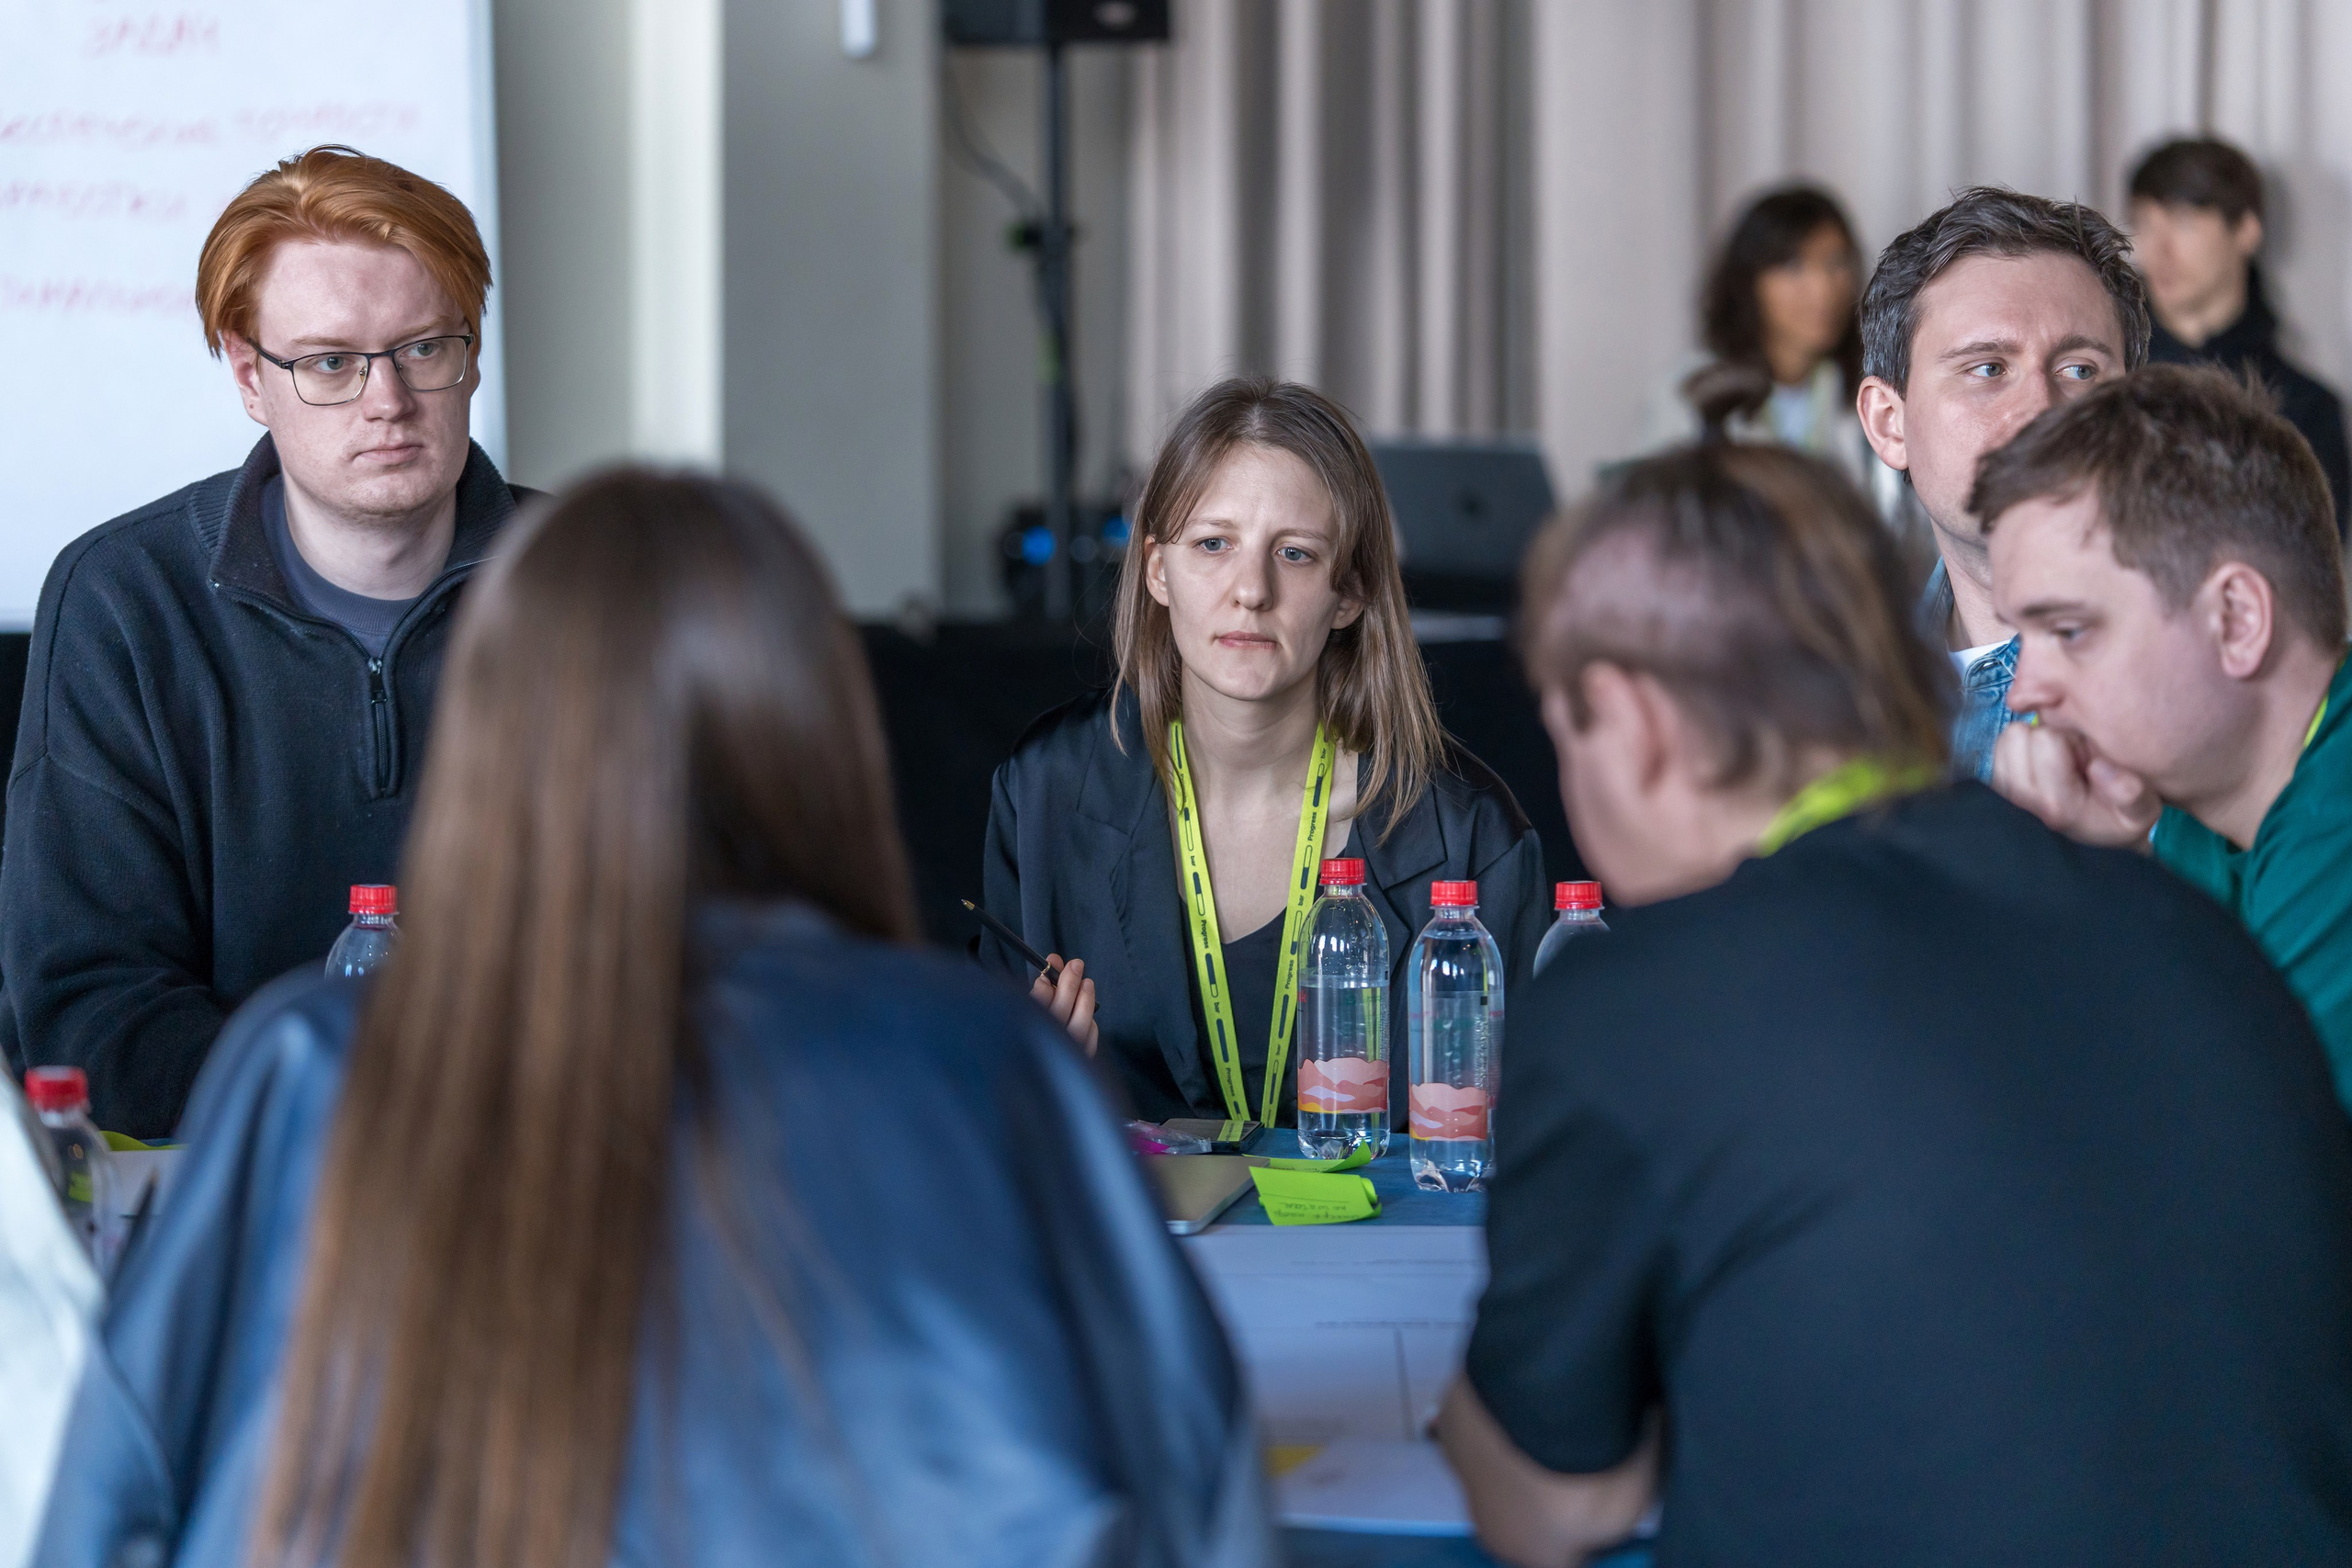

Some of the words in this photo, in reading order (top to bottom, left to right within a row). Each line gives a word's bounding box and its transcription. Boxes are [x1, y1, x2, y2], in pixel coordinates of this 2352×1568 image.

[1284, 959, 1295, 989] Progress
[1307, 812, 1317, 840] Progress
[1201, 919, 1209, 949] Progress
[1226, 1067, 1235, 1097] Progress
